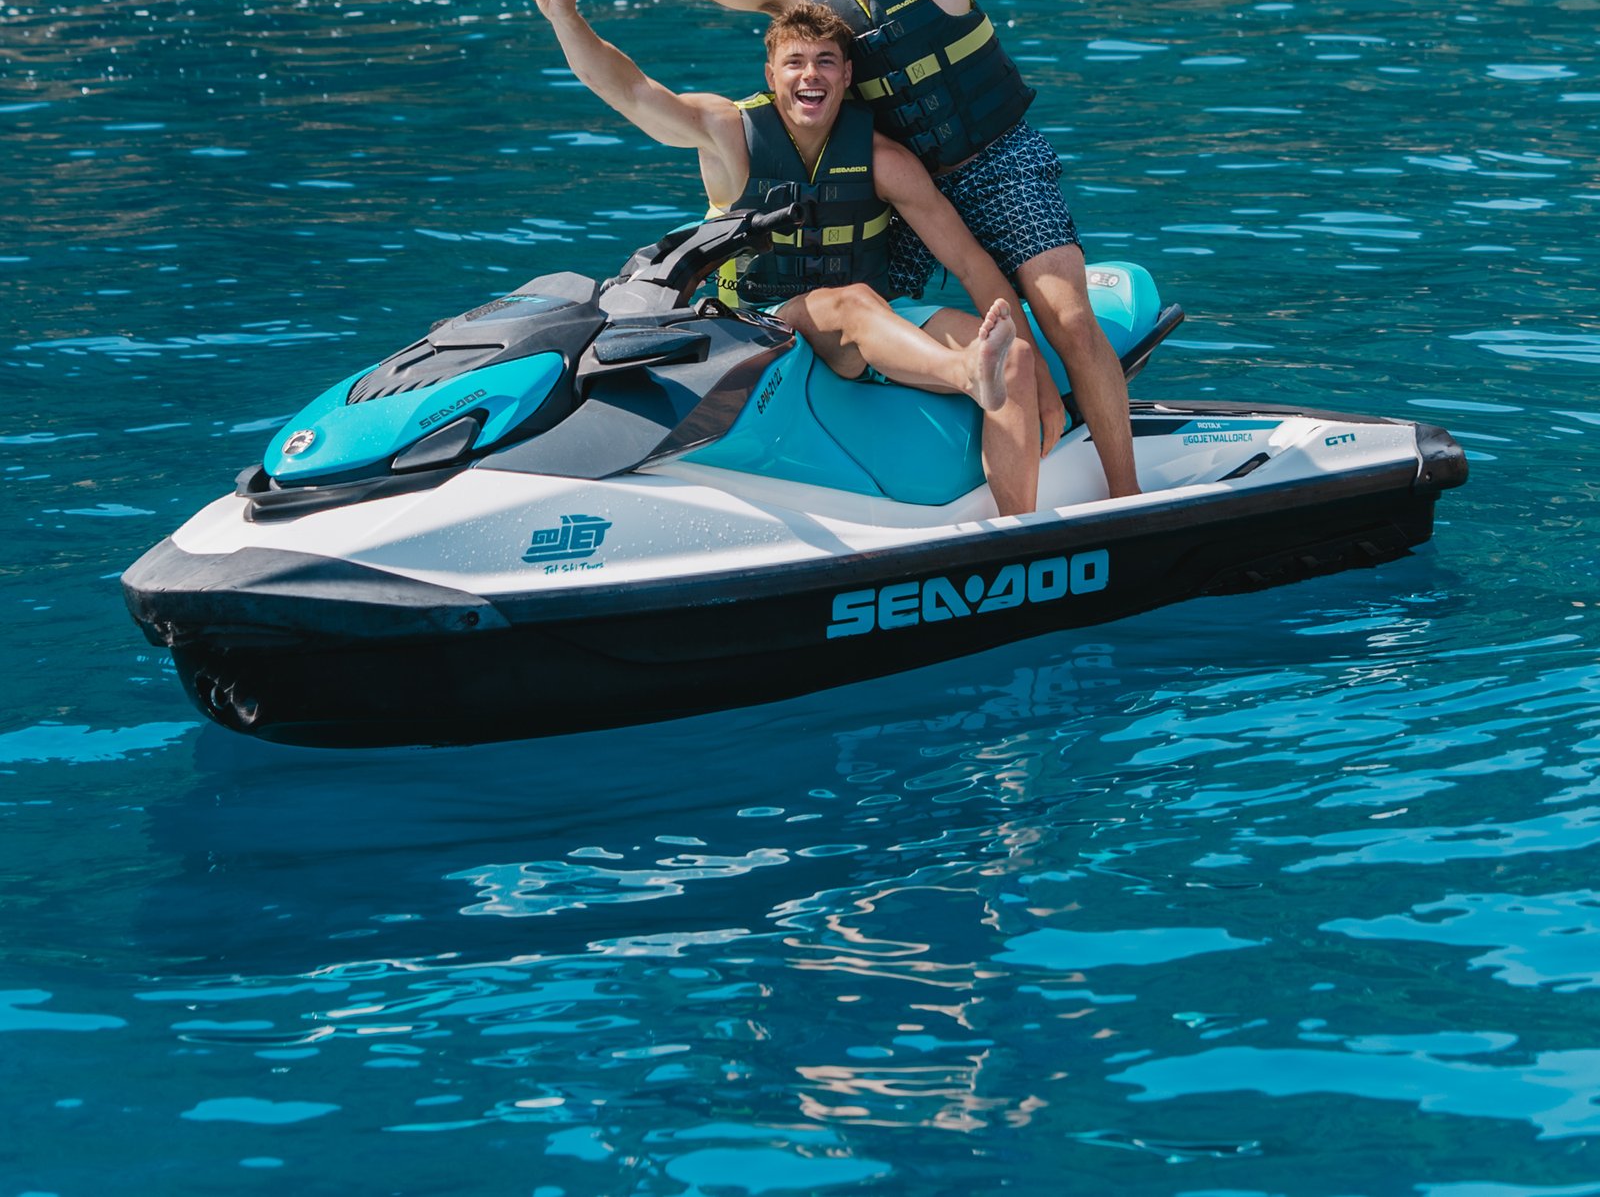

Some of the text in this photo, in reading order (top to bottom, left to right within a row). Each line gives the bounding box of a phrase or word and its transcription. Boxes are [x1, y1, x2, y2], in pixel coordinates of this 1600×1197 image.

[1183, 433, 1253, 445] @GOJETMALLORCA
[1325, 433, 1356, 447] GTI
[543, 562, 605, 575] Jet Ski Tours
